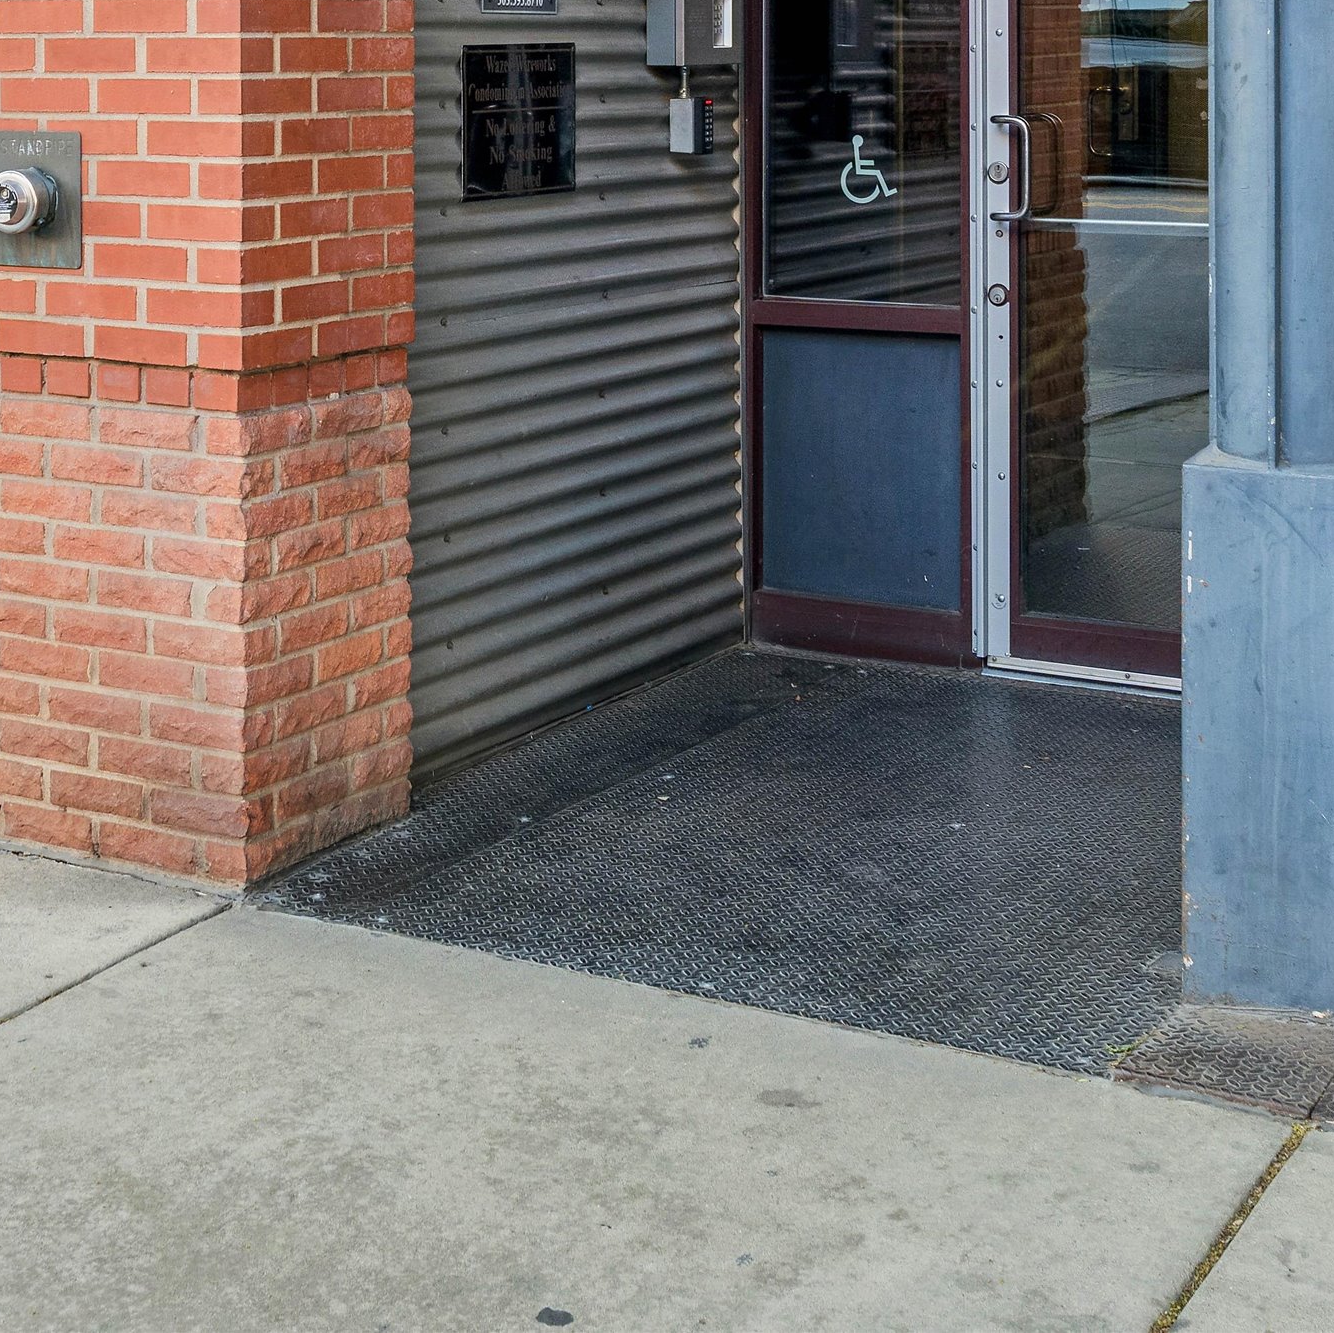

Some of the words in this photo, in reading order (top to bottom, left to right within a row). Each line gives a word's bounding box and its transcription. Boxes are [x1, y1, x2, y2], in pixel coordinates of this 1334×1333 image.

[485, 117, 499, 138] No
[548, 115, 556, 133] &
[489, 145, 505, 166] No
